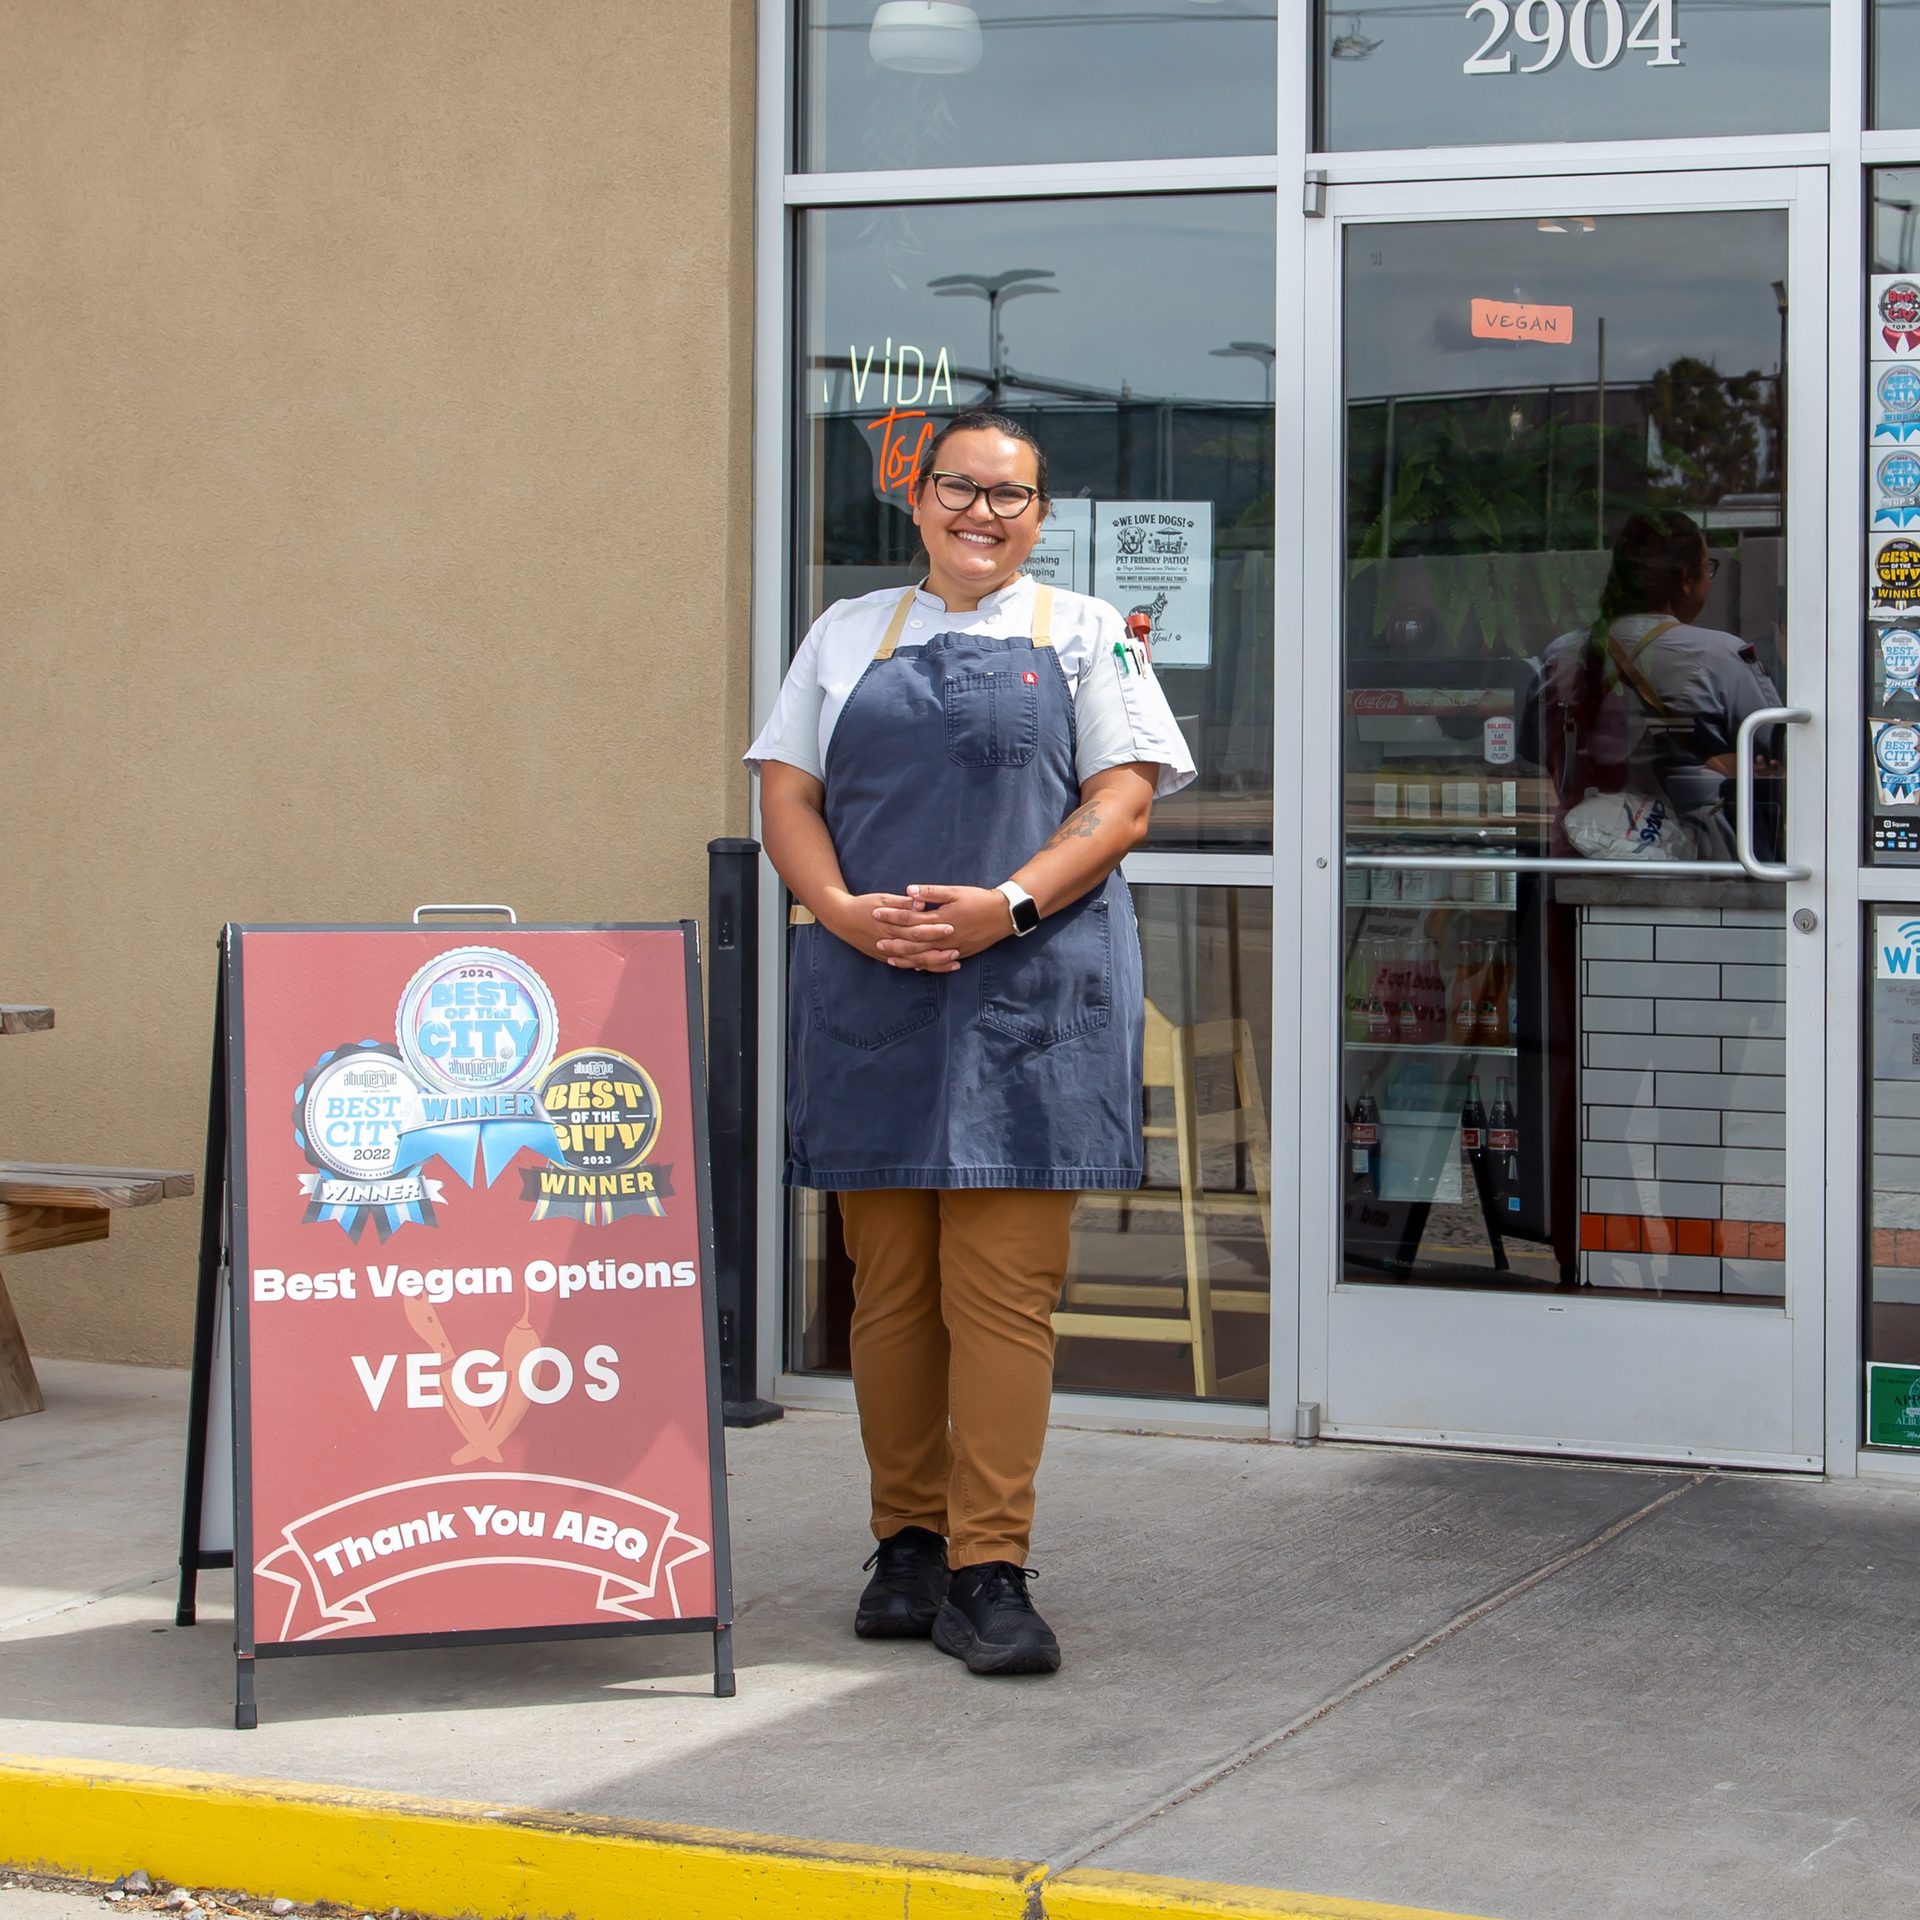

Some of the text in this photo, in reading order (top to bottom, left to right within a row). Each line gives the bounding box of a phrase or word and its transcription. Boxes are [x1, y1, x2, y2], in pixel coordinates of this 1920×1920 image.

[1463, 0, 1681, 74] 2904
[1485, 313, 1557, 332] VEGAN
[867, 406, 934, 506] Tof
[1119, 514, 1187, 528] WE LOVE DOGS!
[1024, 555, 1060, 566] moking
[1115, 556, 1189, 565] PET FRIENDLY PATIO!
[1880, 550, 1920, 564] BEST
[1025, 567, 1055, 578] Vaping
[1880, 568, 1920, 581] CITY
[1151, 633, 1172, 646] You!
[1886, 646, 1914, 656] BEST
[1885, 656, 1919, 667] CITY
[1884, 741, 1914, 751] BEST
[1884, 750, 1917, 761] CITY
[1892, 821, 1910, 829] Square
[1883, 946, 1920, 974] Wi
[459, 969, 494, 979] 2024
[431, 981, 520, 1008] BEST
[444, 1007, 512, 1020] OF THE
[418, 1020, 540, 1059] CITY
[449, 1059, 508, 1078] albuquerque
[573, 1061, 614, 1076] albuquerque
[343, 1070, 398, 1088] albuquerque
[544, 1080, 644, 1111] BEST
[325, 1096, 401, 1119] BEST
[421, 1094, 536, 1122] WINNER
[571, 1111, 620, 1124] OF THE
[553, 1123, 646, 1152] CITY
[353, 1149, 391, 1161] 2022
[582, 1155, 612, 1166] 2023
[540, 1171, 655, 1196] WINNER
[322, 1182, 421, 1202] WINNER
[253, 1259, 696, 1303] Best Vegan Options
[350, 1344, 621, 1412] VEGOS
[313, 1504, 649, 1577] Thank You ABQ
